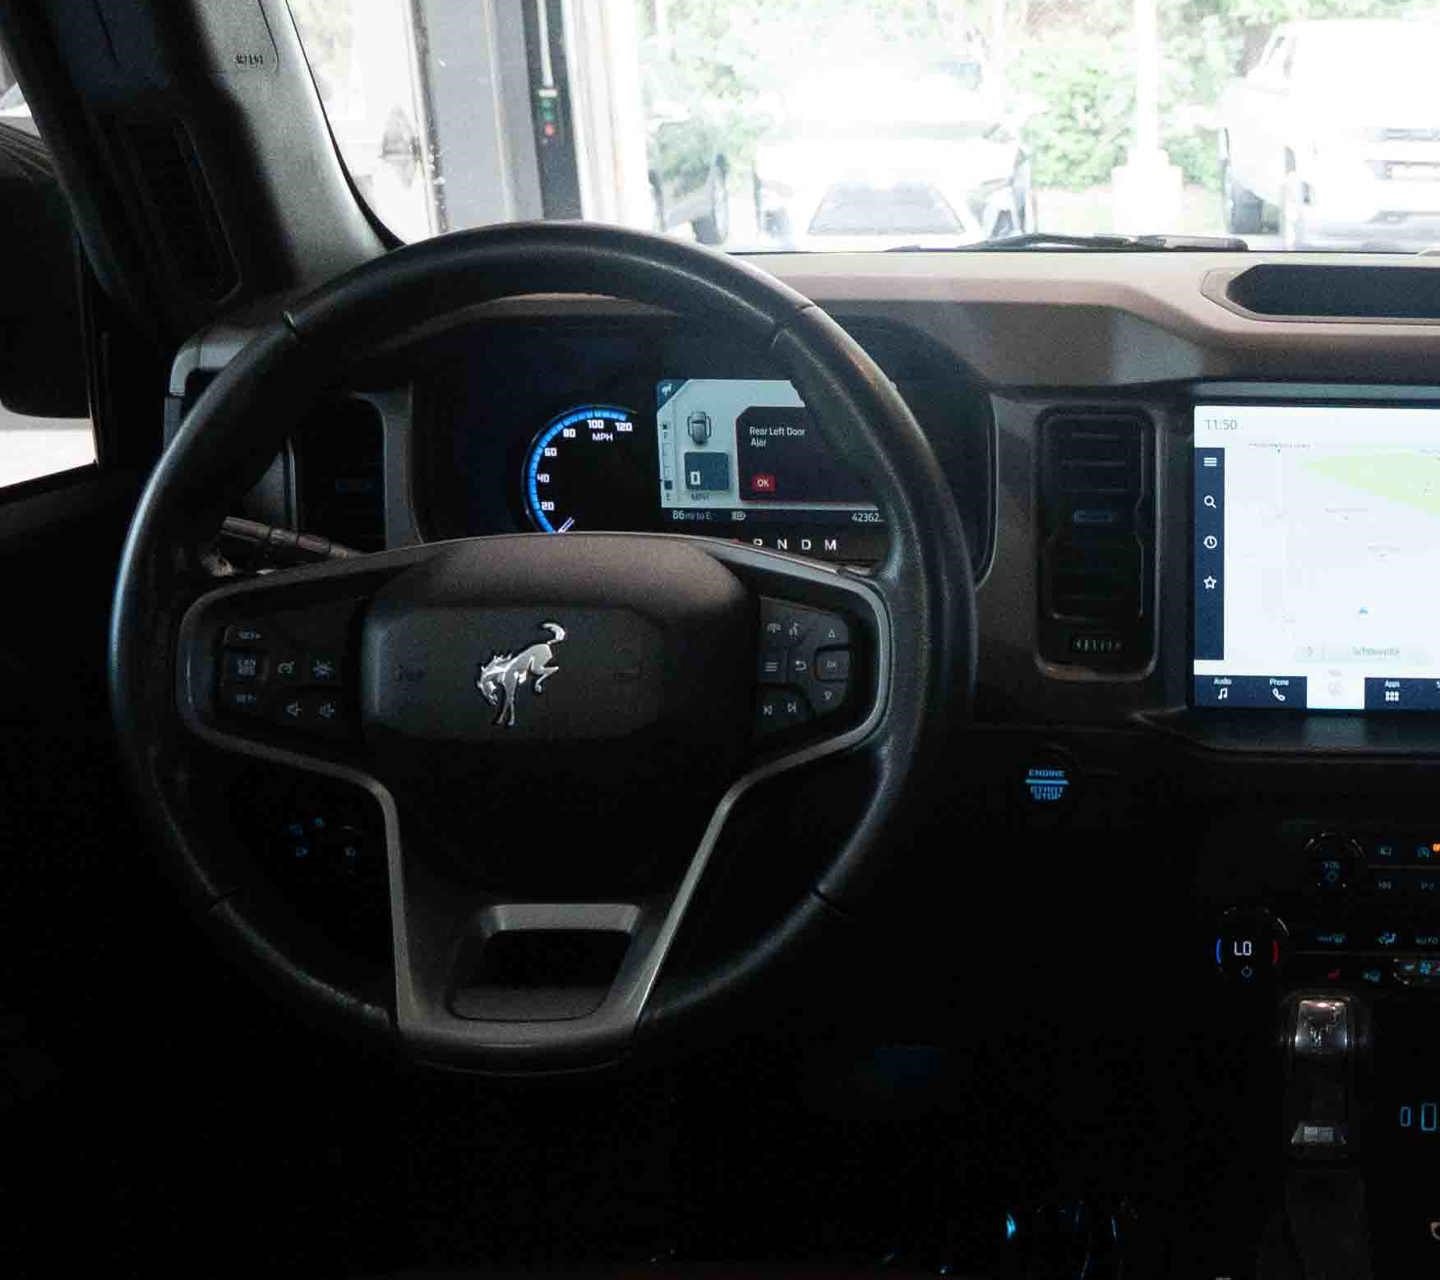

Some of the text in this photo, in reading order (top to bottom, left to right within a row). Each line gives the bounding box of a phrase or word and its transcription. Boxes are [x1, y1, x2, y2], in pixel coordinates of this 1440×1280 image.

[586, 419, 605, 429] 100
[615, 422, 633, 432] 120
[1205, 418, 1238, 431] 11:50
[749, 426, 806, 436] Rear Left Door
[592, 432, 614, 442] MPH
[544, 447, 558, 457] 60
[536, 473, 550, 483] 40
[756, 478, 771, 488] OK
[541, 501, 555, 511] 20
[777, 538, 788, 550] N
[801, 538, 812, 551] D
[824, 538, 837, 551] M
[1213, 677, 1233, 686] Audio
[1269, 677, 1290, 687] Phone
[1384, 679, 1401, 689] Apps
[1232, 939, 1253, 958] LO
